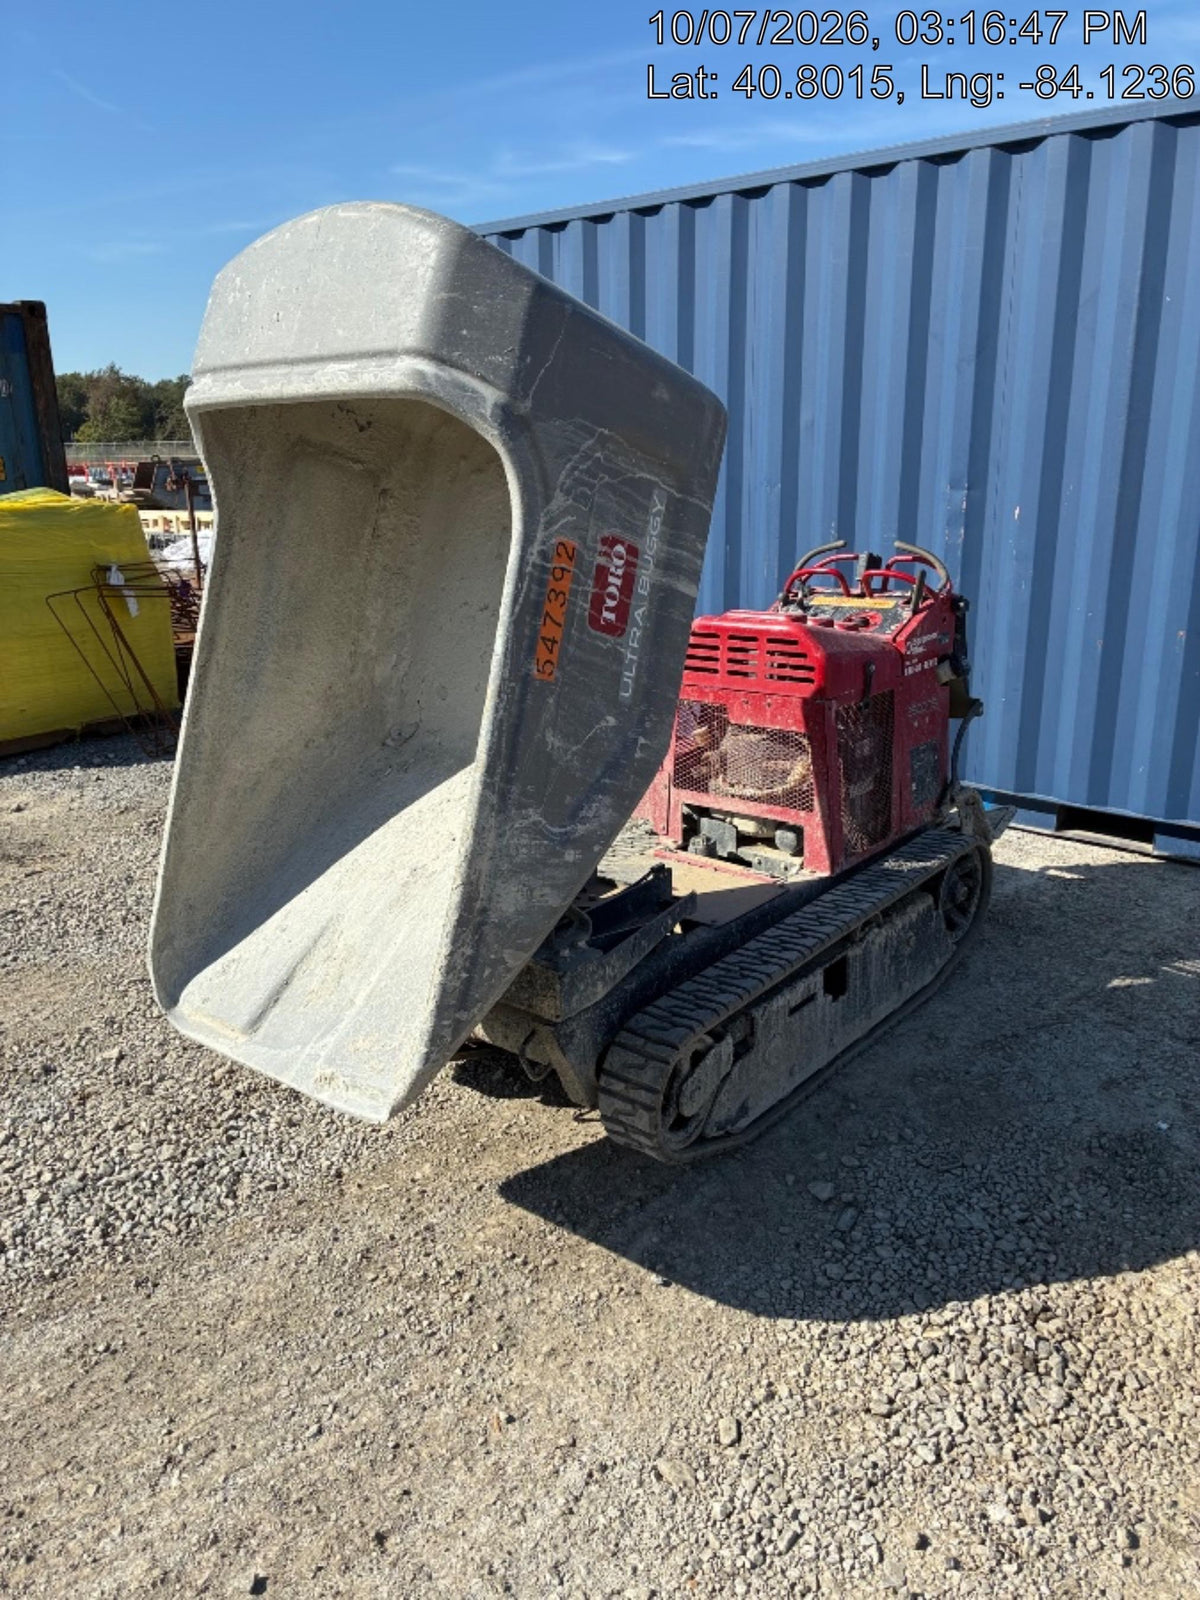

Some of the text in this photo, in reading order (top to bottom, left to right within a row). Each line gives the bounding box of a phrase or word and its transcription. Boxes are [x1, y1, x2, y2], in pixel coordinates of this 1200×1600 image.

[536, 541, 576, 677] 547392
[601, 544, 626, 625] TORO
[619, 492, 667, 699] ULTRA BUGGY
